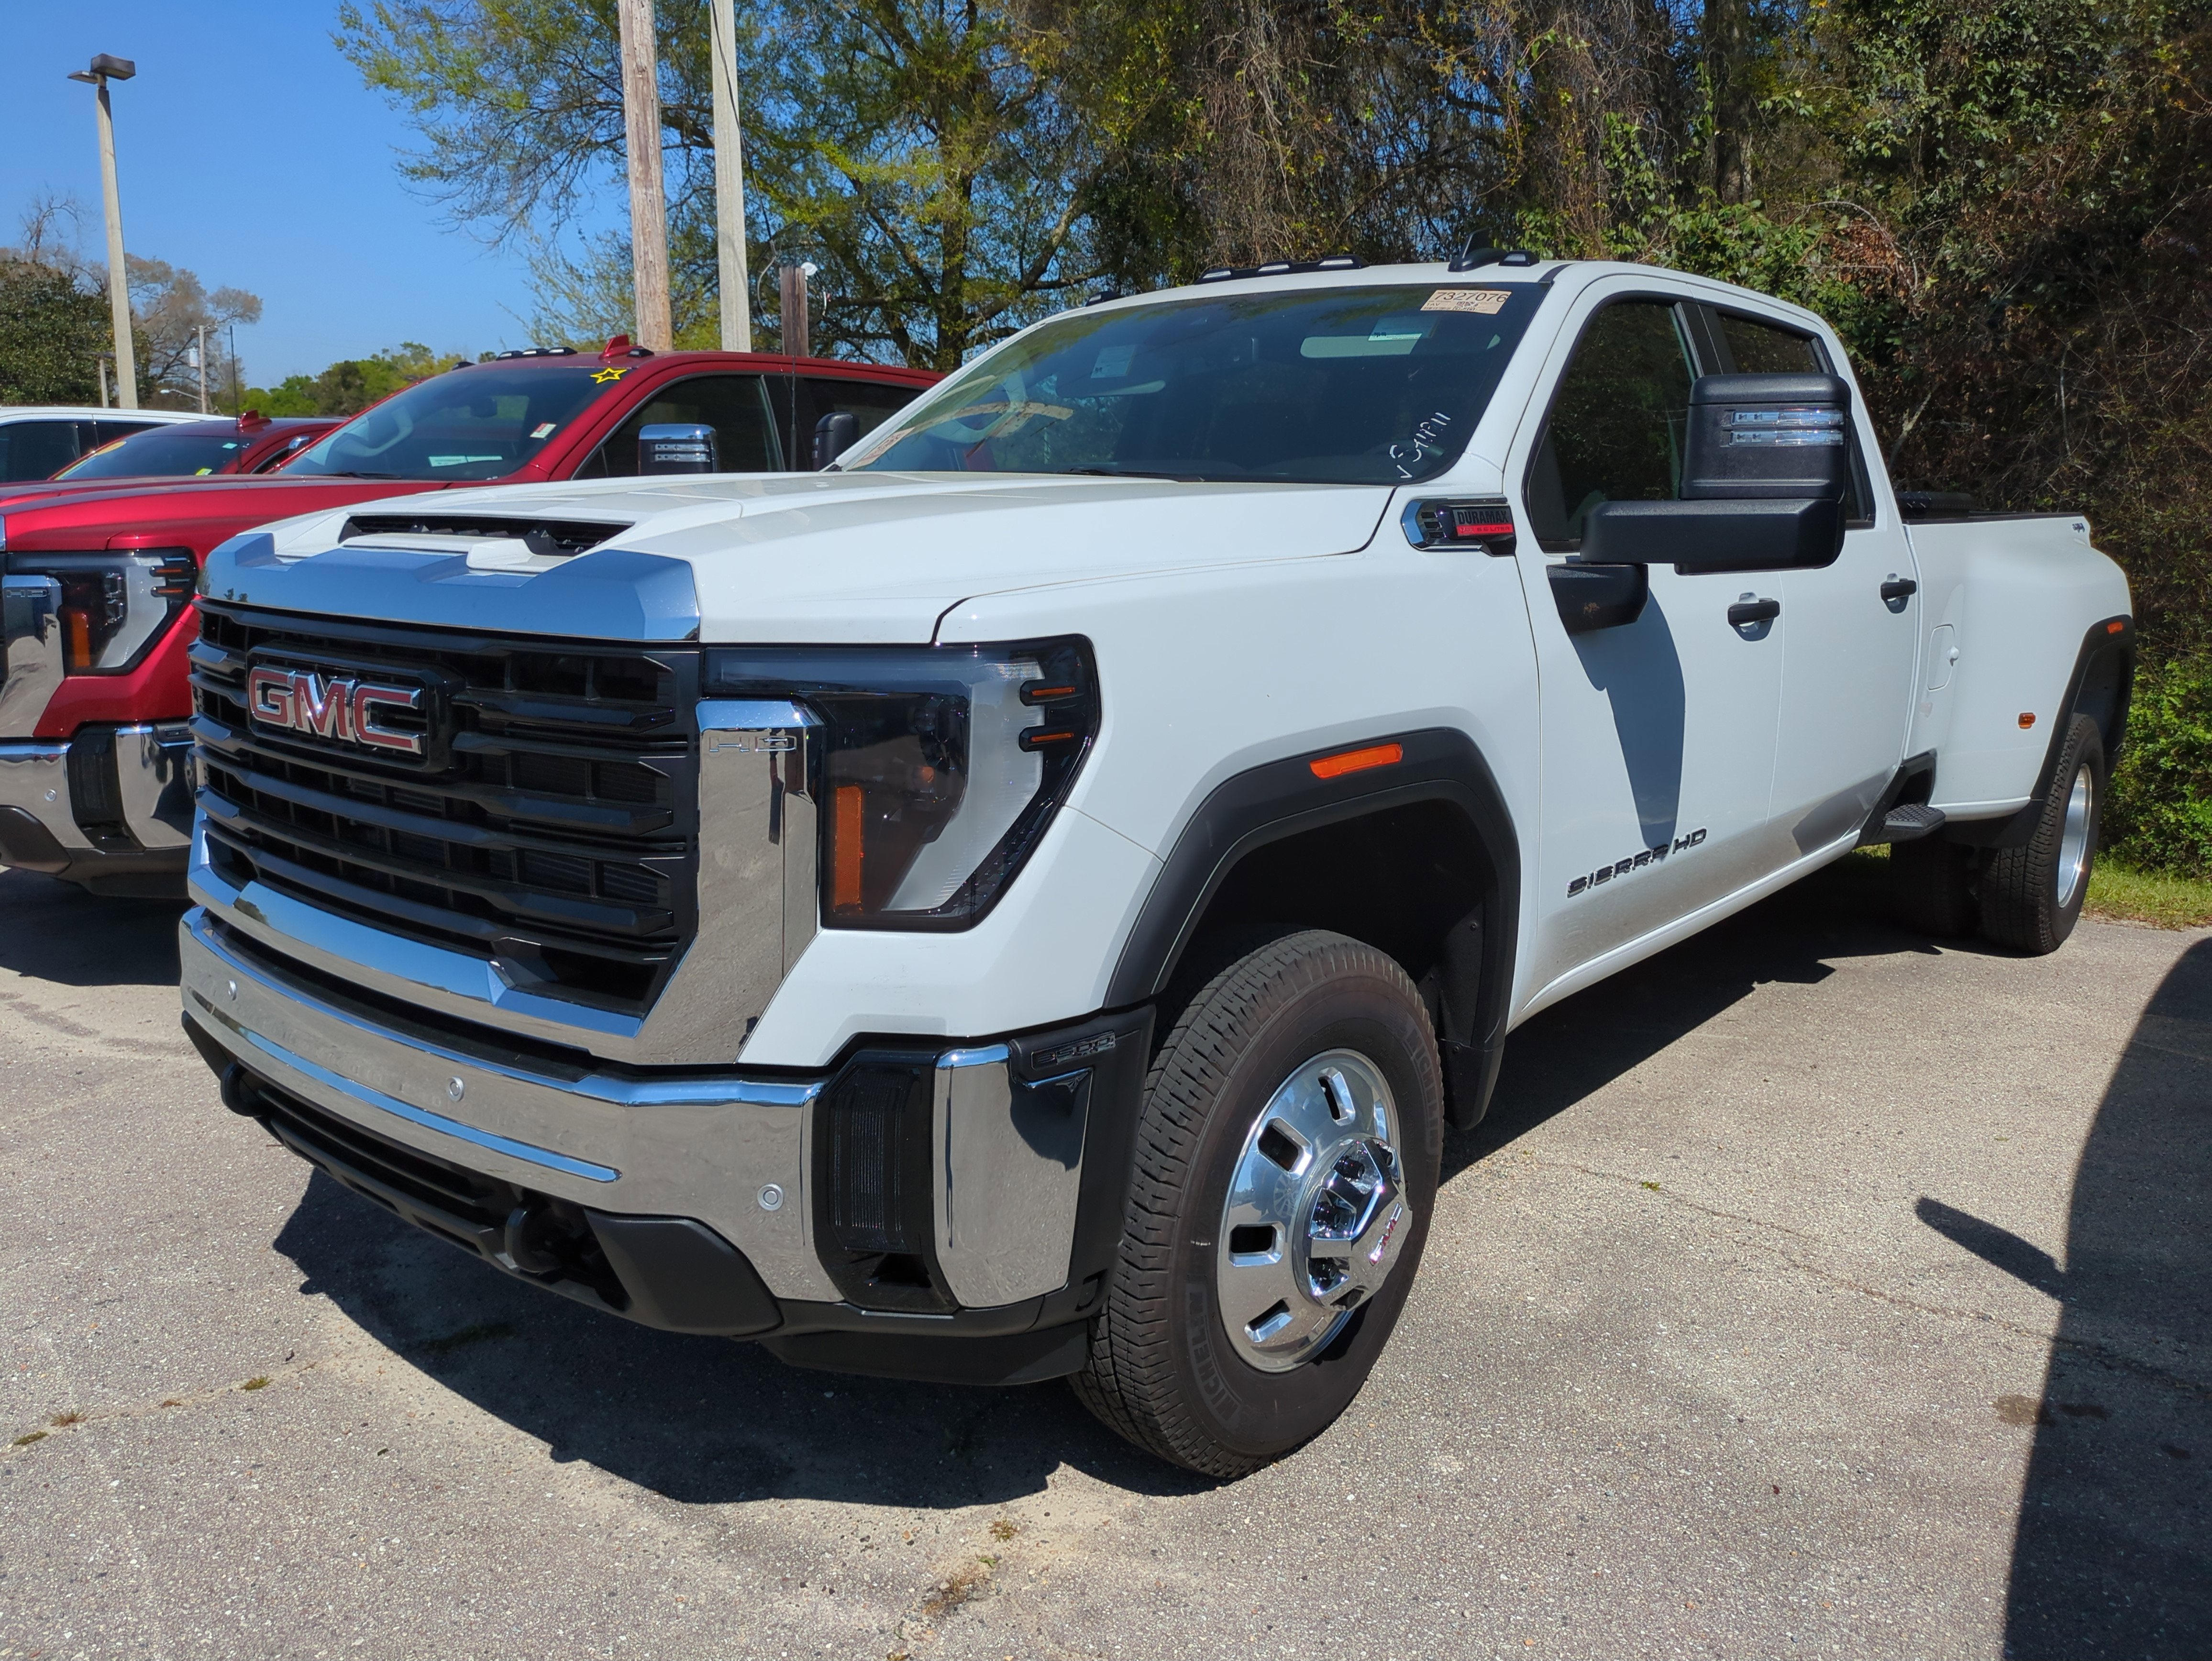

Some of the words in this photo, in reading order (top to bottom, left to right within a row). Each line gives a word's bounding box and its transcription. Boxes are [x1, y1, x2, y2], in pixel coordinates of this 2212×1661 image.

[1435, 292, 1508, 303] 7327076
[1457, 510, 1509, 524] DURAMAX
[6, 589, 47, 598] HD
[249, 665, 424, 754] GMC
[708, 735, 797, 753] HD
[1567, 843, 1669, 898] SIERRA
[1672, 827, 1707, 854] HD
